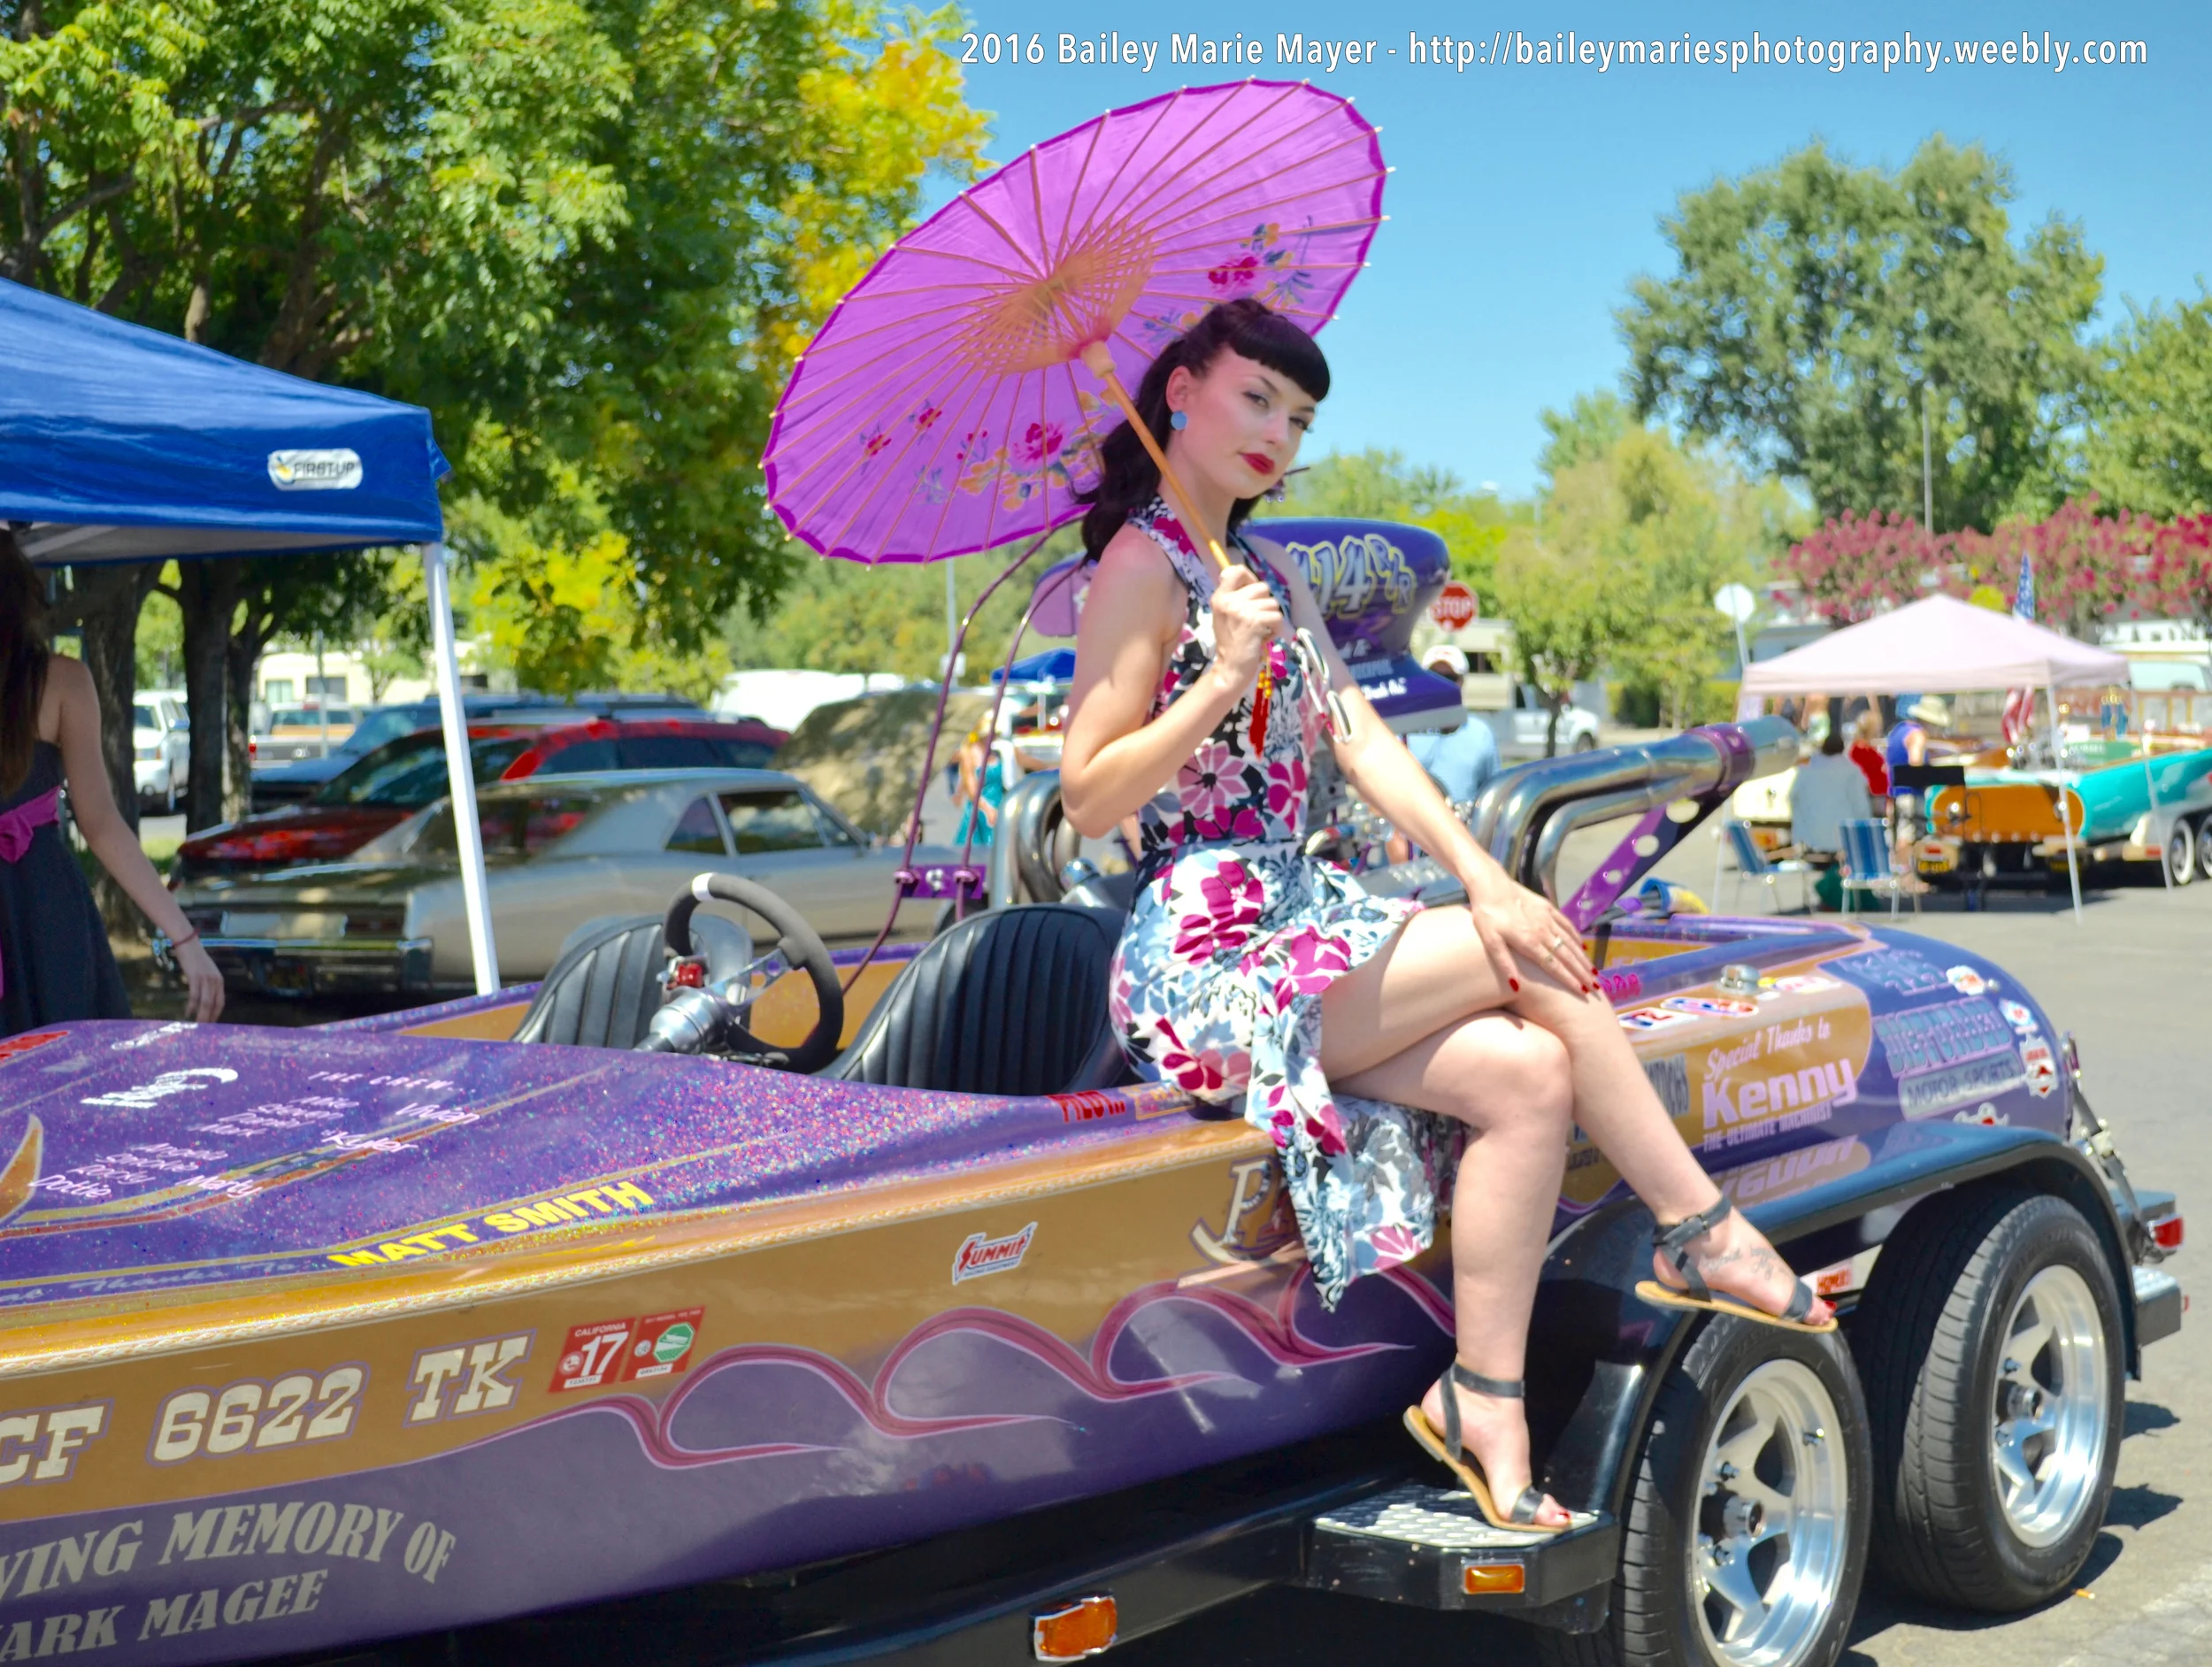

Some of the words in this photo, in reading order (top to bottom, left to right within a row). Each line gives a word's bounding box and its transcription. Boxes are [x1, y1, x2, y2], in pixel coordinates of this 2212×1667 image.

[1432, 595, 1473, 618] STOP
[1704, 1029, 1763, 1083] Special
[1766, 1018, 1813, 1056] Thanks
[1817, 1015, 1831, 1041] to
[1701, 1057, 1857, 1131] Kenny
[1907, 1075, 1958, 1109] MOTOR
[1963, 1058, 2016, 1090] SPORTS
[1702, 1131, 1724, 1154] THE
[1726, 1117, 1778, 1148] ULTIMATE
[28, 1173, 112, 1198] Dottie
[326, 1223, 480, 1268] MATT
[483, 1180, 655, 1233] SMITH
[574, 1322, 626, 1338] CALIFORNIA
[580, 1331, 630, 1377] 17
[0, 1405, 106, 1484] CF
[151, 1366, 364, 1463] 6622
[407, 1335, 529, 1423] TK
[157, 1500, 406, 1567] MEMORY
[403, 1521, 457, 1585] OF
[0, 1604, 122, 1663] ARK
[136, 1568, 329, 1641] MAGEE
